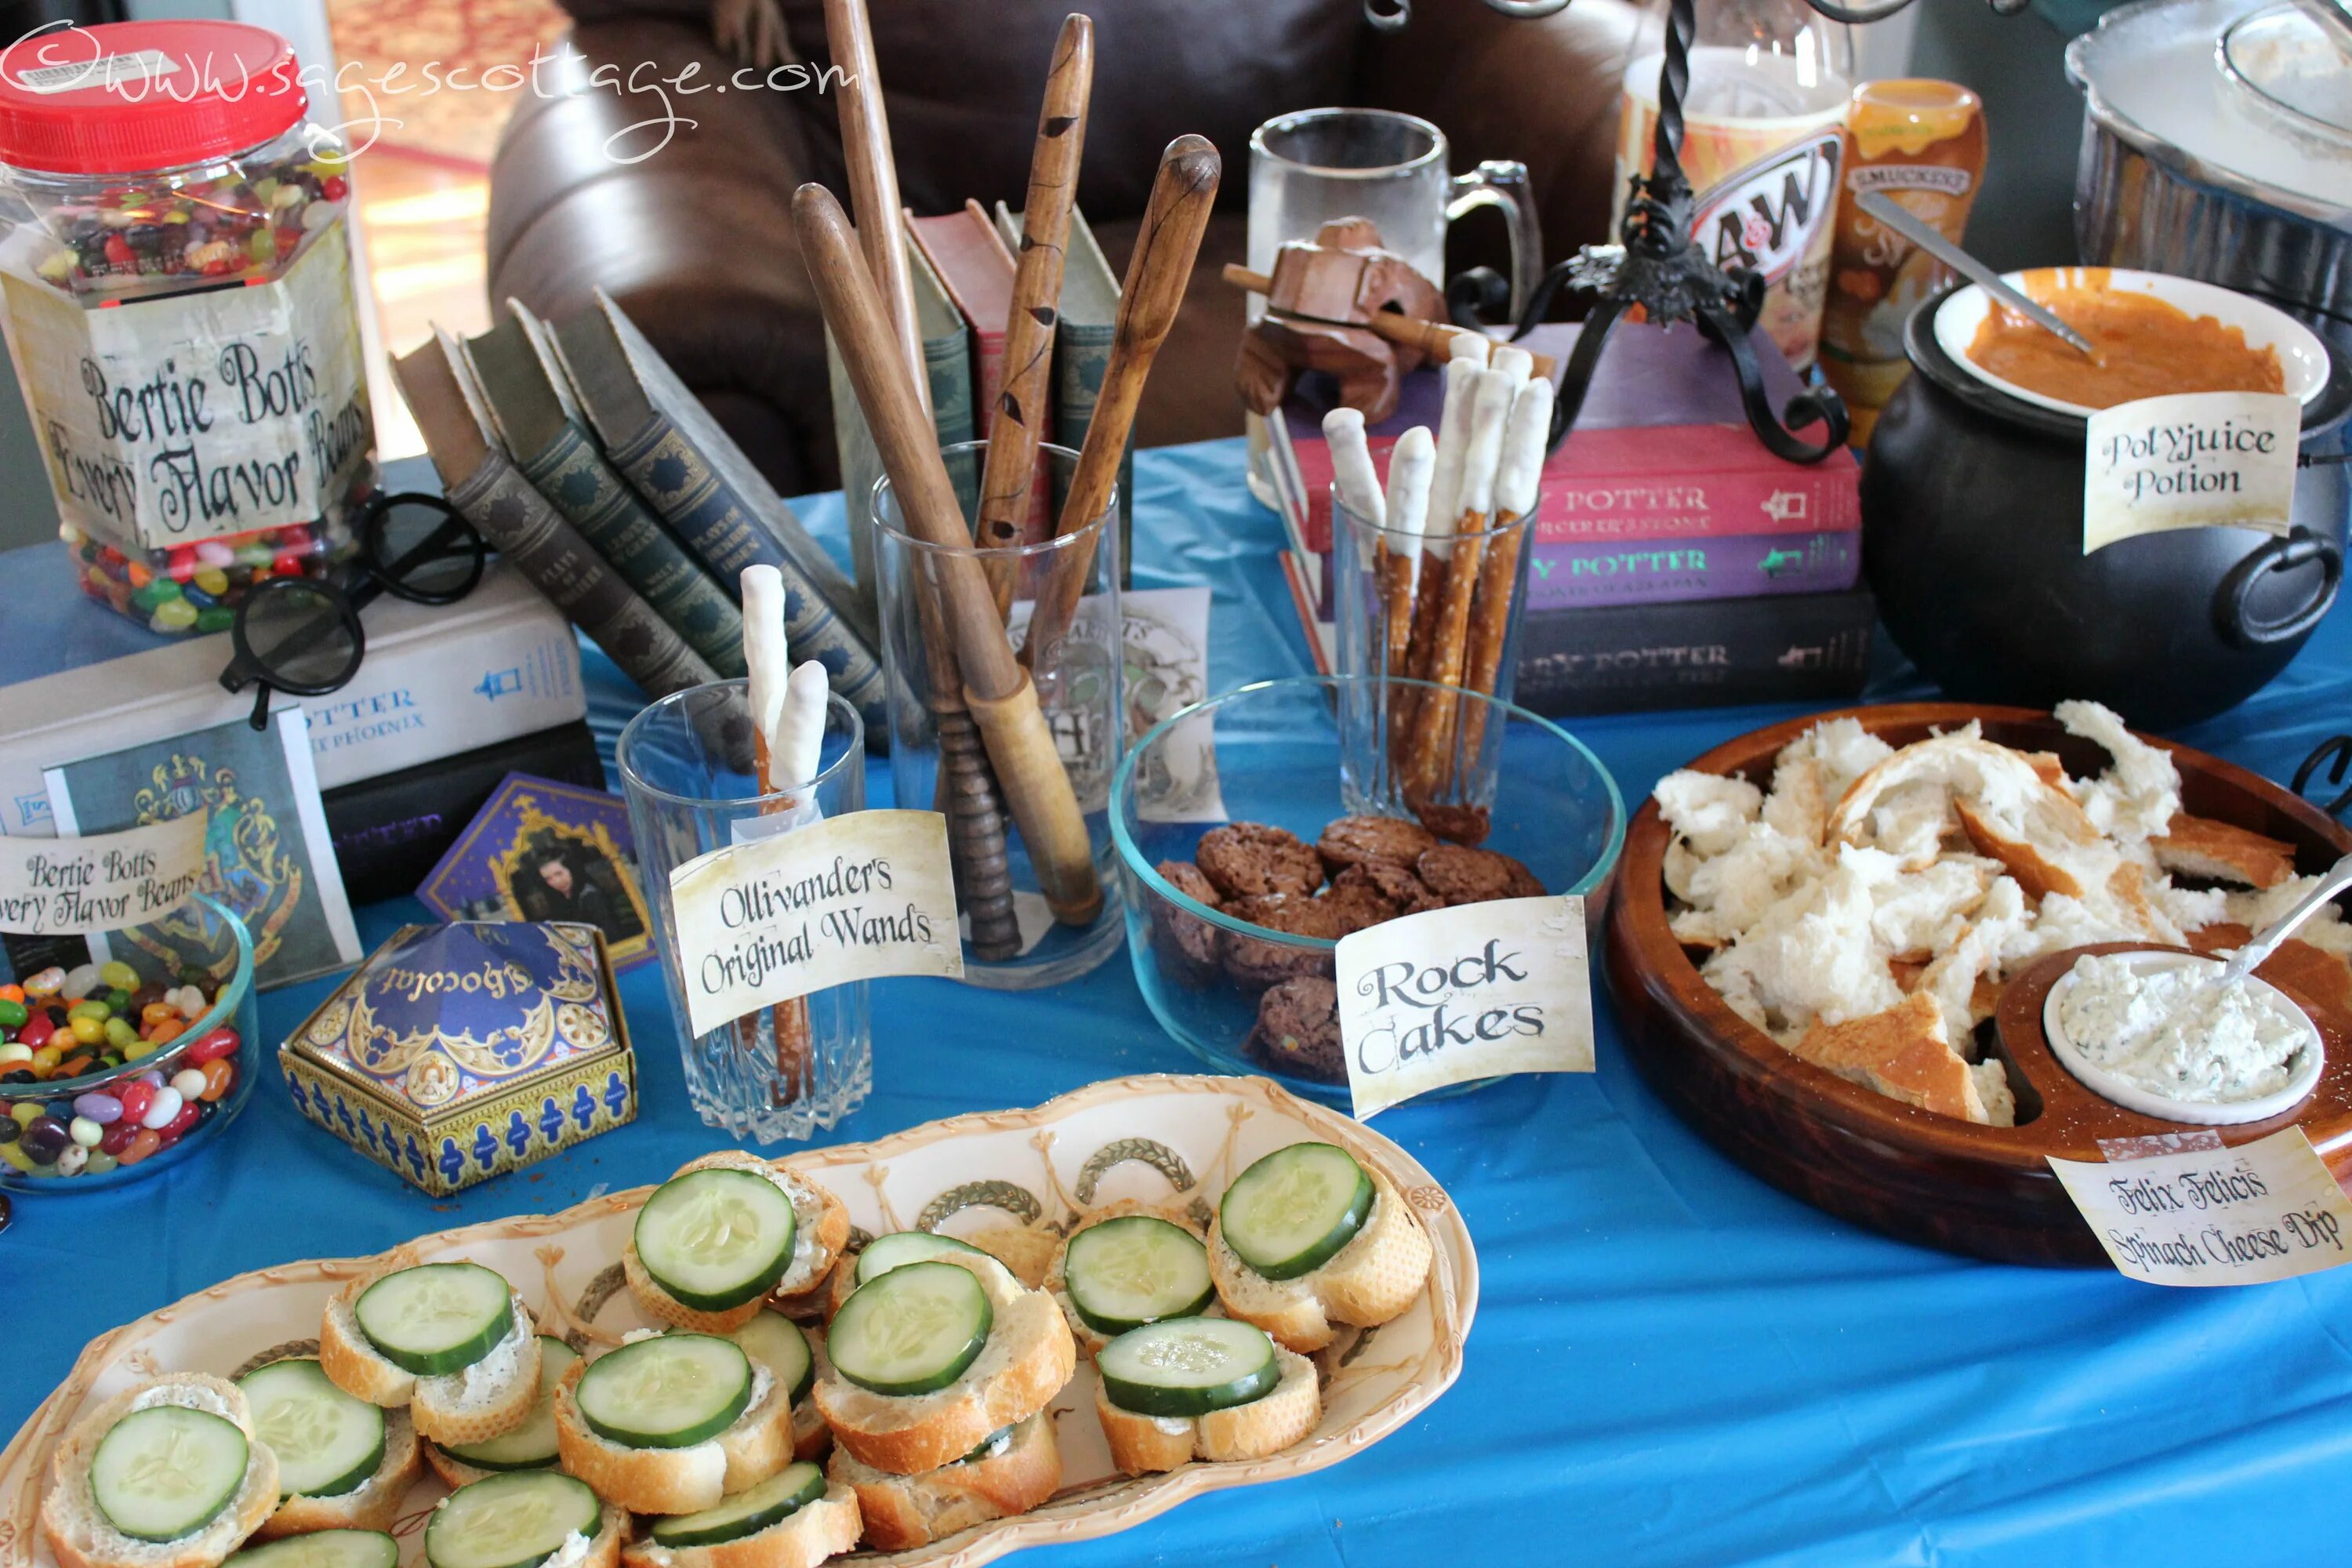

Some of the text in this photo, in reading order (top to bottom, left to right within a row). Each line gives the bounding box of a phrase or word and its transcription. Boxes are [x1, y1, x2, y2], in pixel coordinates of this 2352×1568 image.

[1716, 172, 1809, 267] A&W
[82, 357, 214, 441] Bertie
[2102, 420, 2276, 472] Polyjuice
[49, 421, 151, 546] Every
[151, 445, 300, 533] Flavor
[1566, 485, 1710, 511] POTTER
[2123, 463, 2242, 507] Potion
[1572, 549, 1708, 577] POTTER
[1592, 644, 1731, 671] POTTER
[304, 688, 416, 730] TTER
[333, 713, 426, 748] PHOENIX
[27, 854, 95, 888] Bertie
[720, 856, 893, 928] Ollivander's
[0, 872, 195, 934] very Flavor Beans
[700, 903, 932, 995] Original Wands
[1357, 938, 1527, 1009] Rock
[1358, 1004, 1545, 1075] Cakes
[2108, 1165, 2268, 1214] Felix Felicis
[2107, 1206, 2344, 1272] Spinach Cheese Dip
